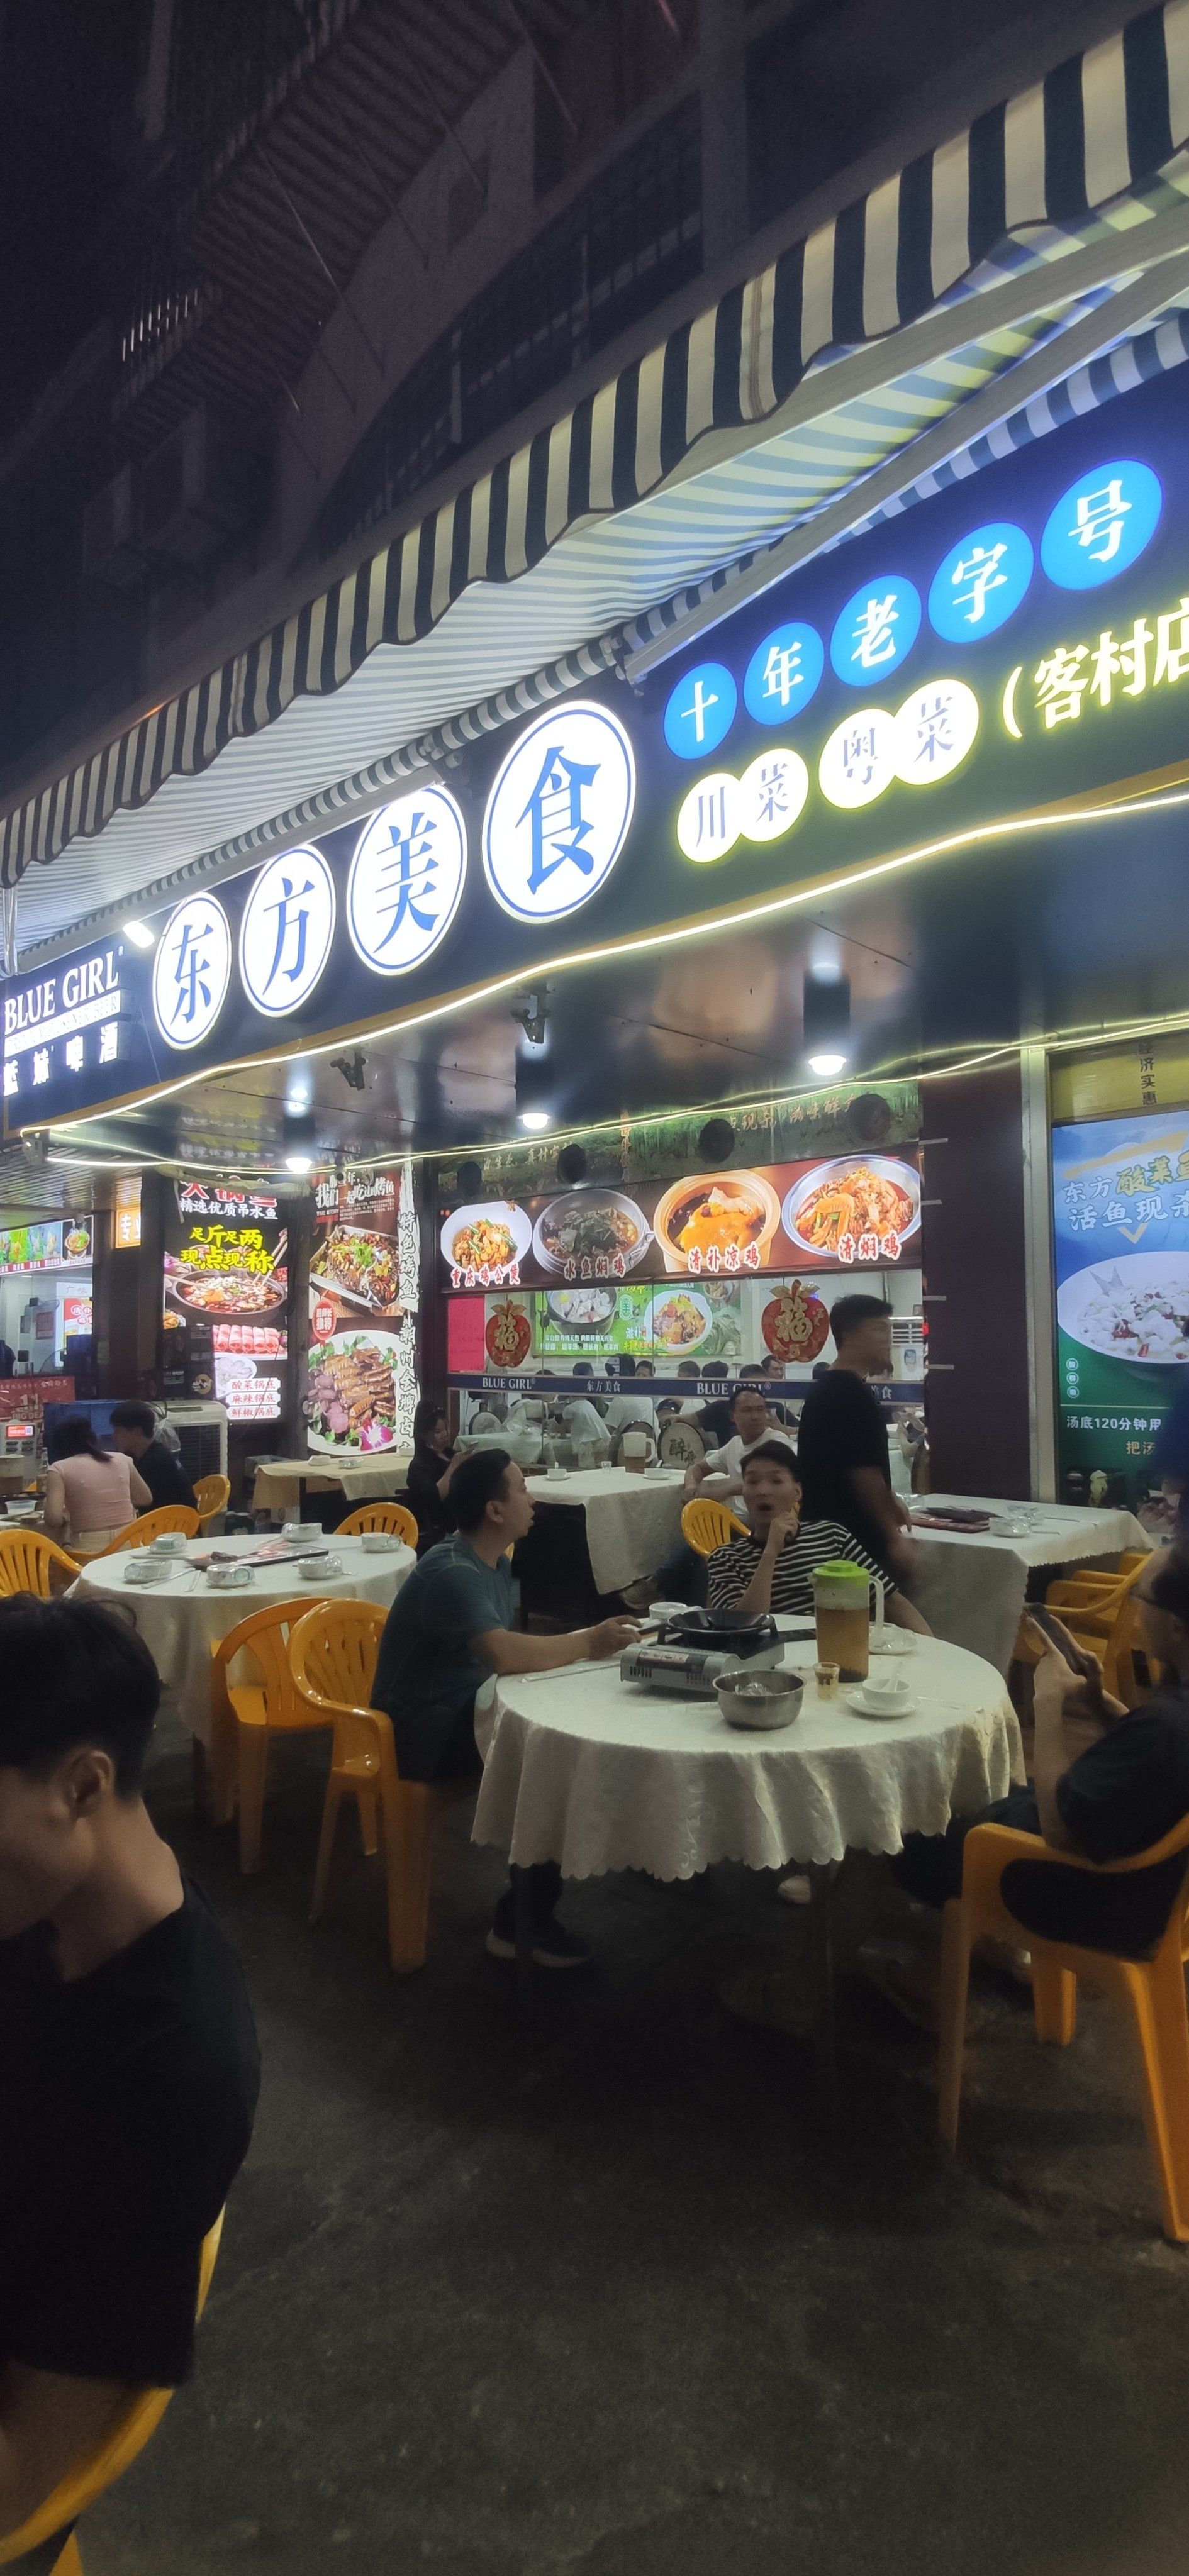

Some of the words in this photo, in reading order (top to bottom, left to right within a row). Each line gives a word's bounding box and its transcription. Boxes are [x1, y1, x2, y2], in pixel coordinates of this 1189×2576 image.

[680, 479, 1132, 743] 十年老字号
[695, 762, 789, 849] 川菜
[843, 694, 954, 786] 粤菜
[170, 745, 602, 1026] 东方美食
[4, 978, 57, 1036] BLUE
[62, 950, 119, 1008] GIRL
[180, 1245, 275, 1274] 现点现称
[189, 1224, 264, 1250] 足斤足两
[399, 1210, 416, 1300] 特色烤鱼
[483, 1377, 505, 1389] BLUE
[508, 1378, 532, 1390] GIRL
[586, 1380, 621, 1392] 东方美食
[696, 1382, 728, 1395] BLUE
